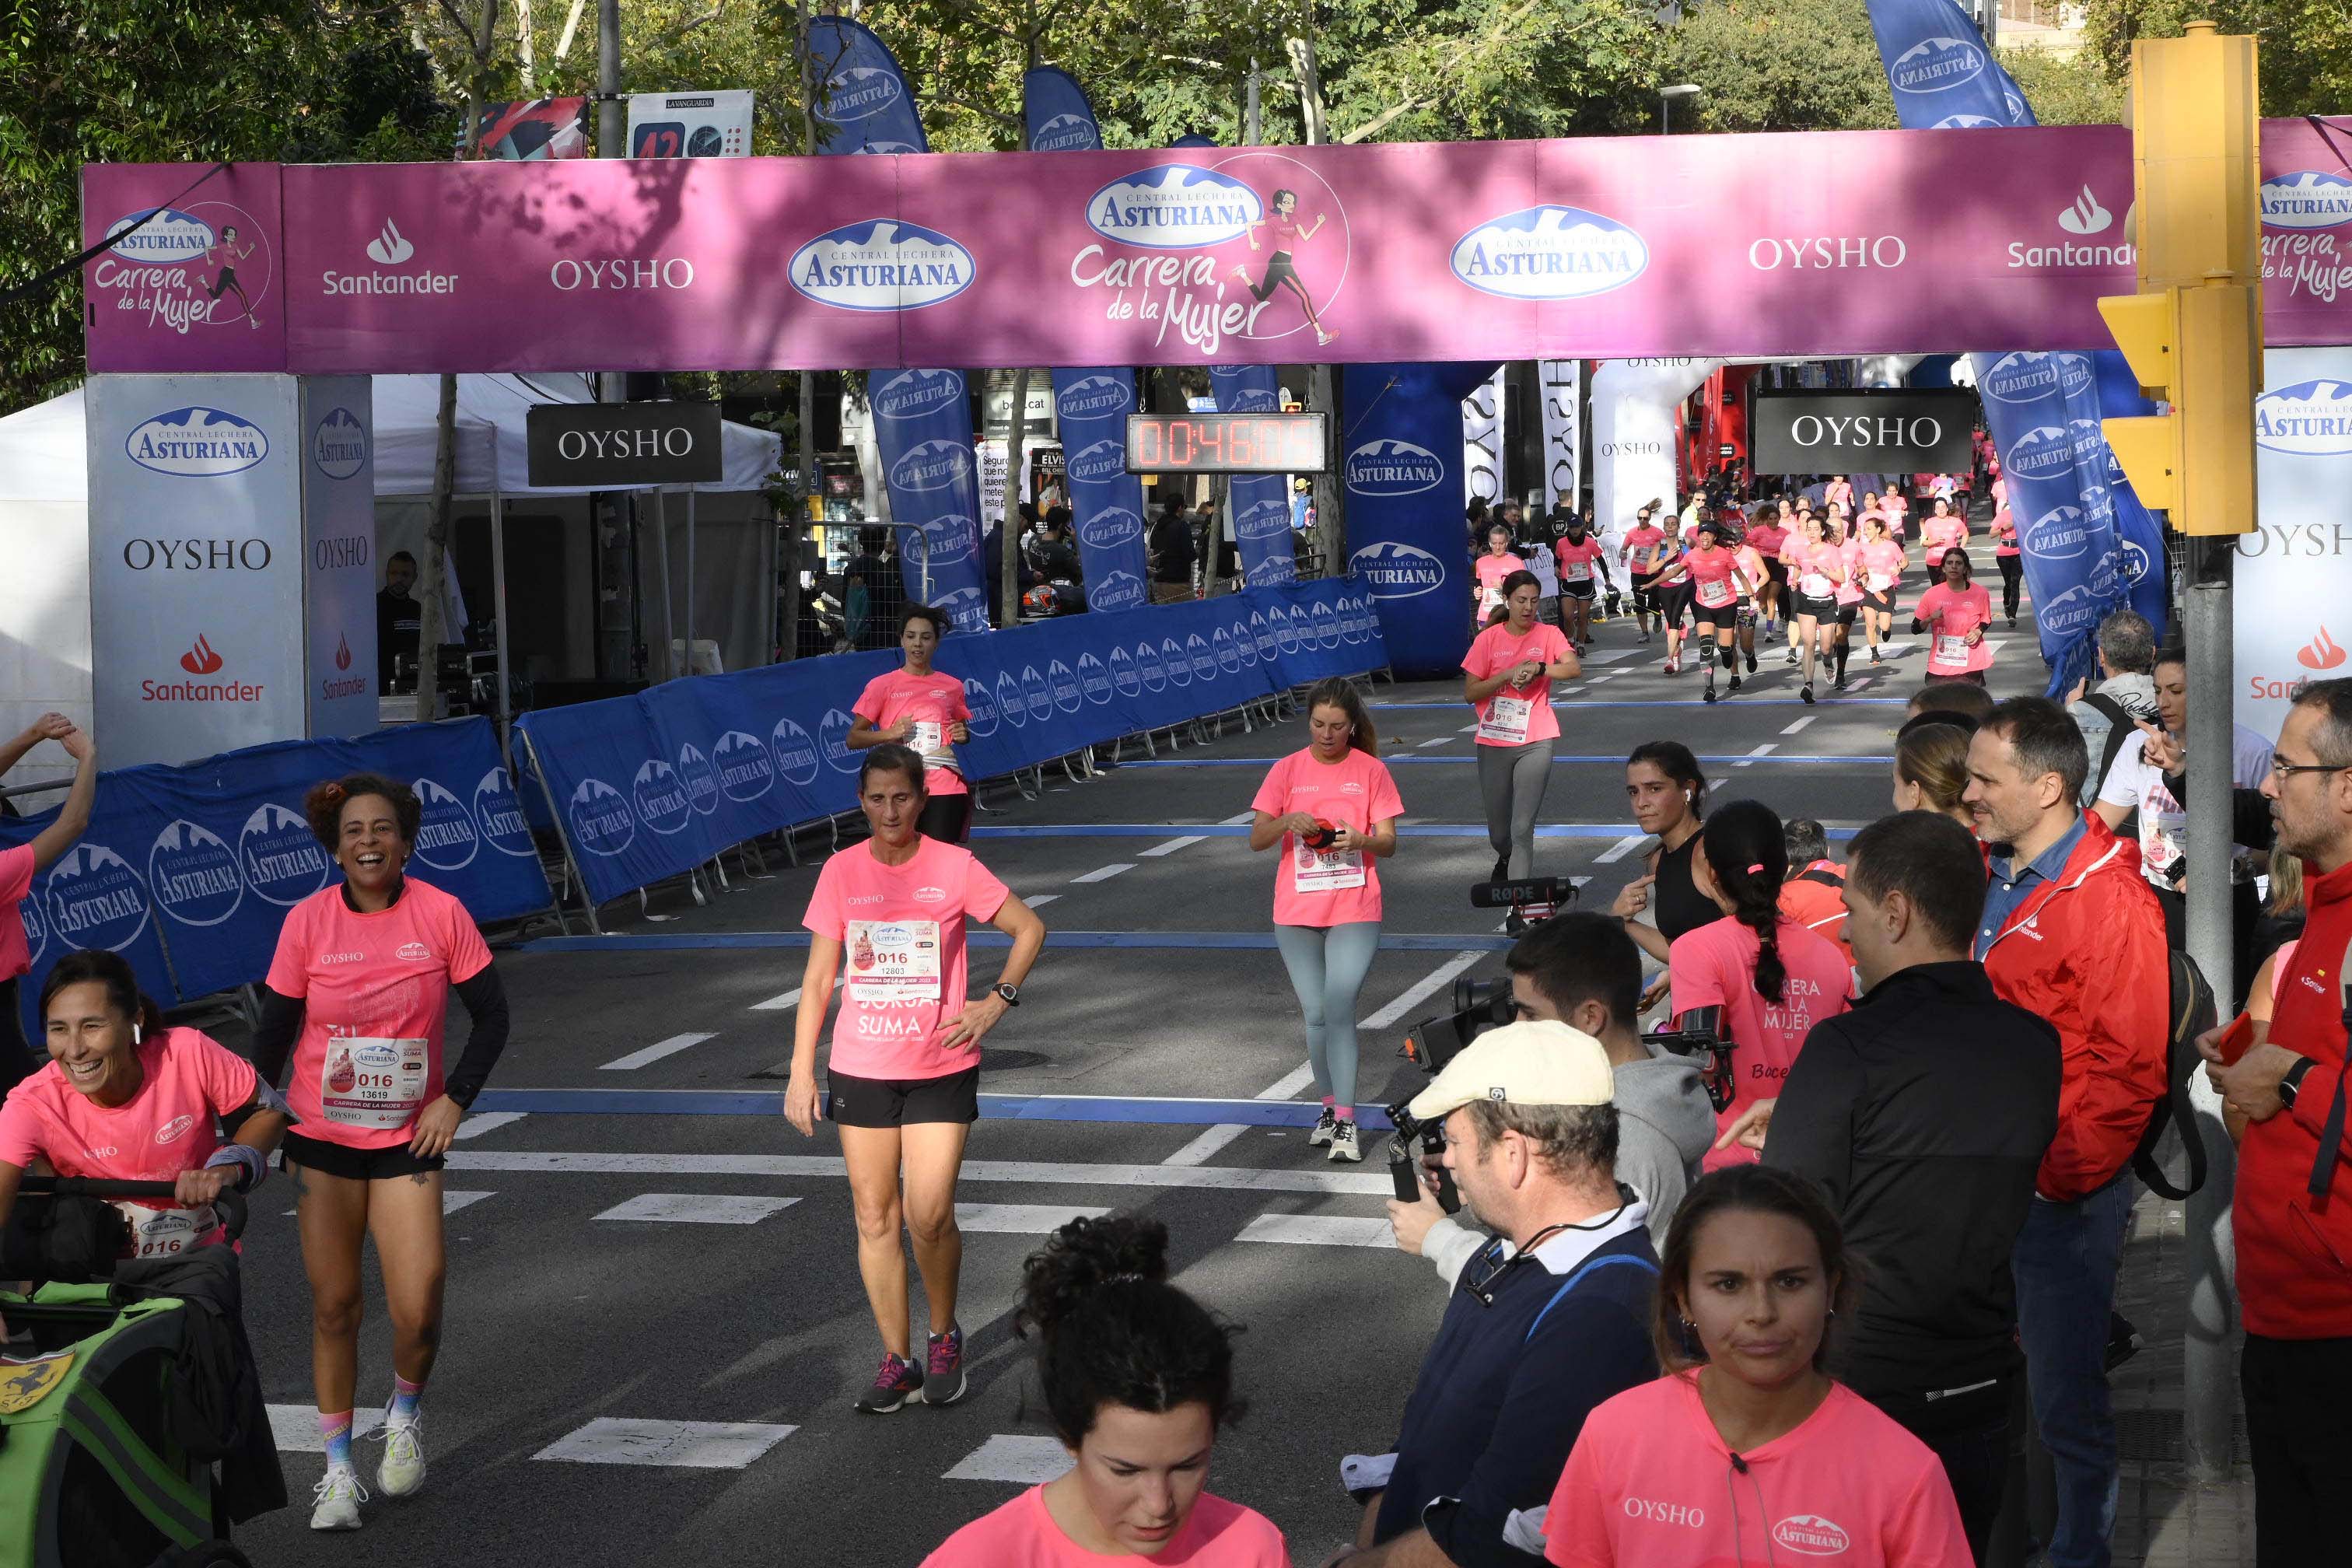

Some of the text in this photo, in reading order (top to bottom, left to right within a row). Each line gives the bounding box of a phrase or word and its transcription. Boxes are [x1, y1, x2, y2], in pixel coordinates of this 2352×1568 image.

[1126, 194, 1182, 202] CENTRAL
[1099, 196, 1248, 227] ASTURIANA
[831, 250, 954, 260] CENTRAL LECHERA
[1465, 242, 1632, 275] ASTURIANA
[1749, 236, 1906, 270] OYSHO
[95, 260, 186, 289] Carrera
[551, 258, 694, 289] OYSHO
[803, 254, 961, 287] ASTURIANA
[1070, 244, 1216, 288] Carrera
[2279, 257, 2293, 278] la
[2290, 252, 2352, 303] Muje
[323, 270, 458, 296] Santander
[117, 286, 221, 334] de la Mujer
[1106, 282, 1271, 355] de la Mujer
[2277, 406, 2329, 415] CENTRAL
[558, 427, 693, 460] OYSHO
[1792, 415, 1942, 447] OYSHO
[137, 432, 259, 459] ASTURIANA
[317, 432, 363, 462] ASTURIANA
[1601, 442, 1661, 457] OYSHO
[1349, 462, 1437, 484] ASTURIANA
[124, 539, 271, 570] OYSHO
[316, 536, 367, 570] OYSHO
[142, 680, 264, 702] Santander
[323, 674, 367, 701] Santander
[1496, 713, 1511, 722] 016
[247, 845, 327, 886] ASTURIANA
[1317, 852, 1339, 862] 016
[157, 863, 240, 905] ASTURIANA
[849, 895, 884, 906] OYSHO
[321, 952, 363, 964] OYSHO
[878, 953, 908, 964] 016
[1789, 996, 1808, 1013] LA
[858, 1015, 922, 1034] SUMA
[357, 1053, 397, 1063] ASTURIANA
[359, 1074, 393, 1087] 016
[361, 1090, 388, 1099] 13619
[331, 1111, 362, 1121] OYSHO
[159, 1118, 193, 1143] ASTURIANA
[144, 1220, 188, 1232] ASTURIANA
[142, 1240, 180, 1255] 016
[1624, 1497, 1705, 1528] OYSHO
[1779, 1525, 1843, 1549] ASTURIANA
